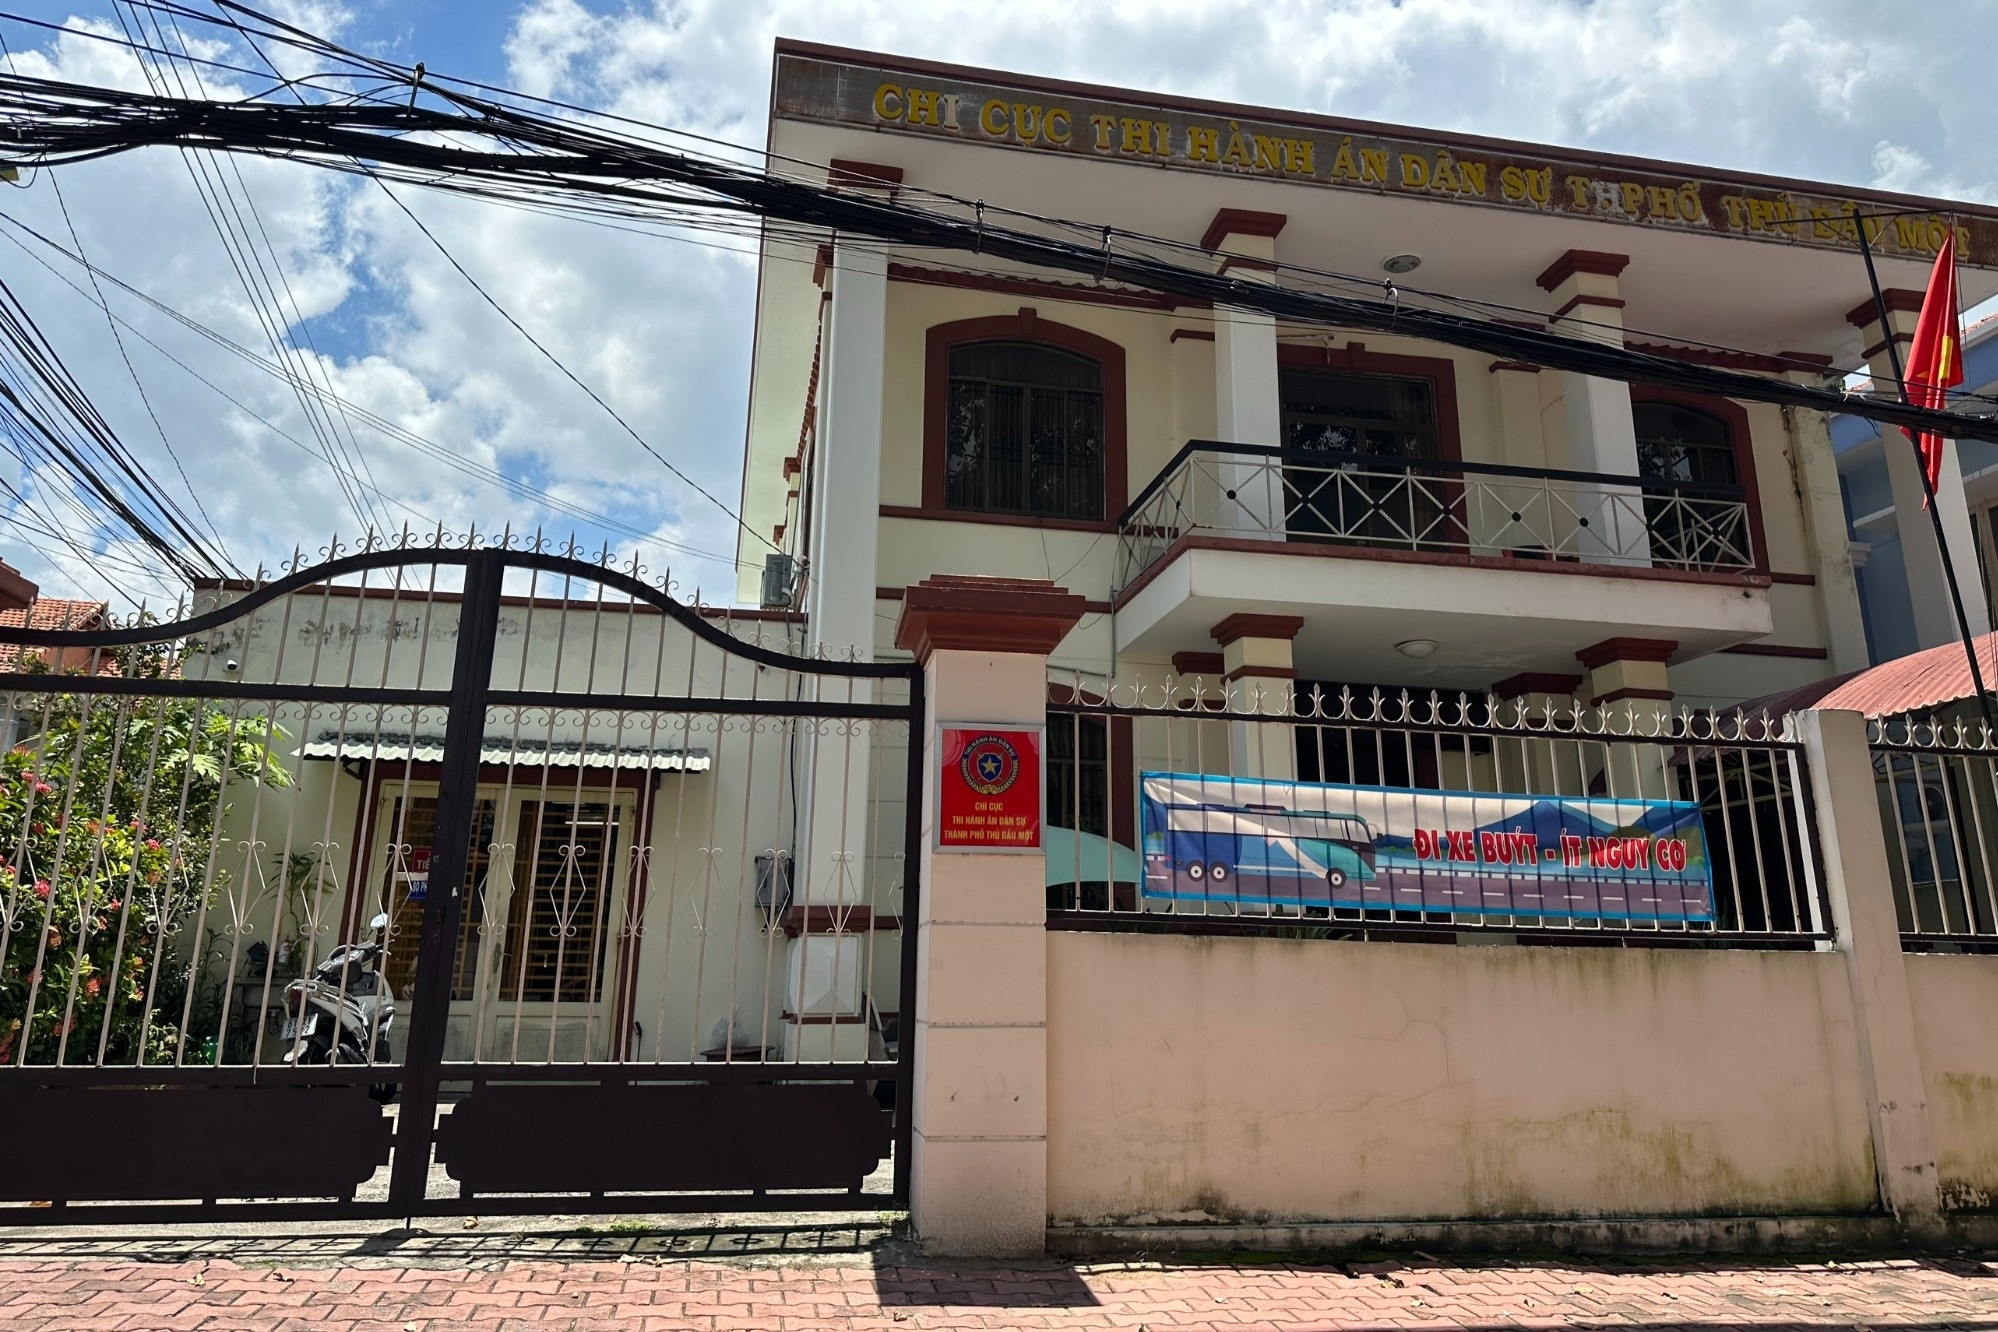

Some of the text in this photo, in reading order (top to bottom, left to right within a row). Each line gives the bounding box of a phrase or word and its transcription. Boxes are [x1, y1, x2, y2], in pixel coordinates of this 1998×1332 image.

[874, 83, 959, 130] CHI
[980, 99, 1072, 148] CỤC
[1090, 114, 1171, 157] THI
[1187, 120, 1315, 174] HÀNH
[1331, 136, 1388, 182] ÁN
[1401, 150, 1486, 195] DÂN
[1501, 166, 1552, 209] SỰ
[975, 801, 1004, 813] CHI CỤC
[952, 814, 1027, 828] THI HÀNH ÁN DÂN SỰ
[944, 828, 968, 840] THÀNH
[970, 828, 985, 840] PHỐ
[986, 828, 1000, 840] THỦ
[1018, 829, 1034, 842] MỘT
[1413, 829, 1442, 862] ĐI
[1445, 830, 1477, 863] XE
[1480, 826, 1538, 866] BUÝT
[1560, 828, 1582, 868] ÍT
[1587, 836, 1650, 871] NGUY
[1656, 838, 1686, 872] CƠ
